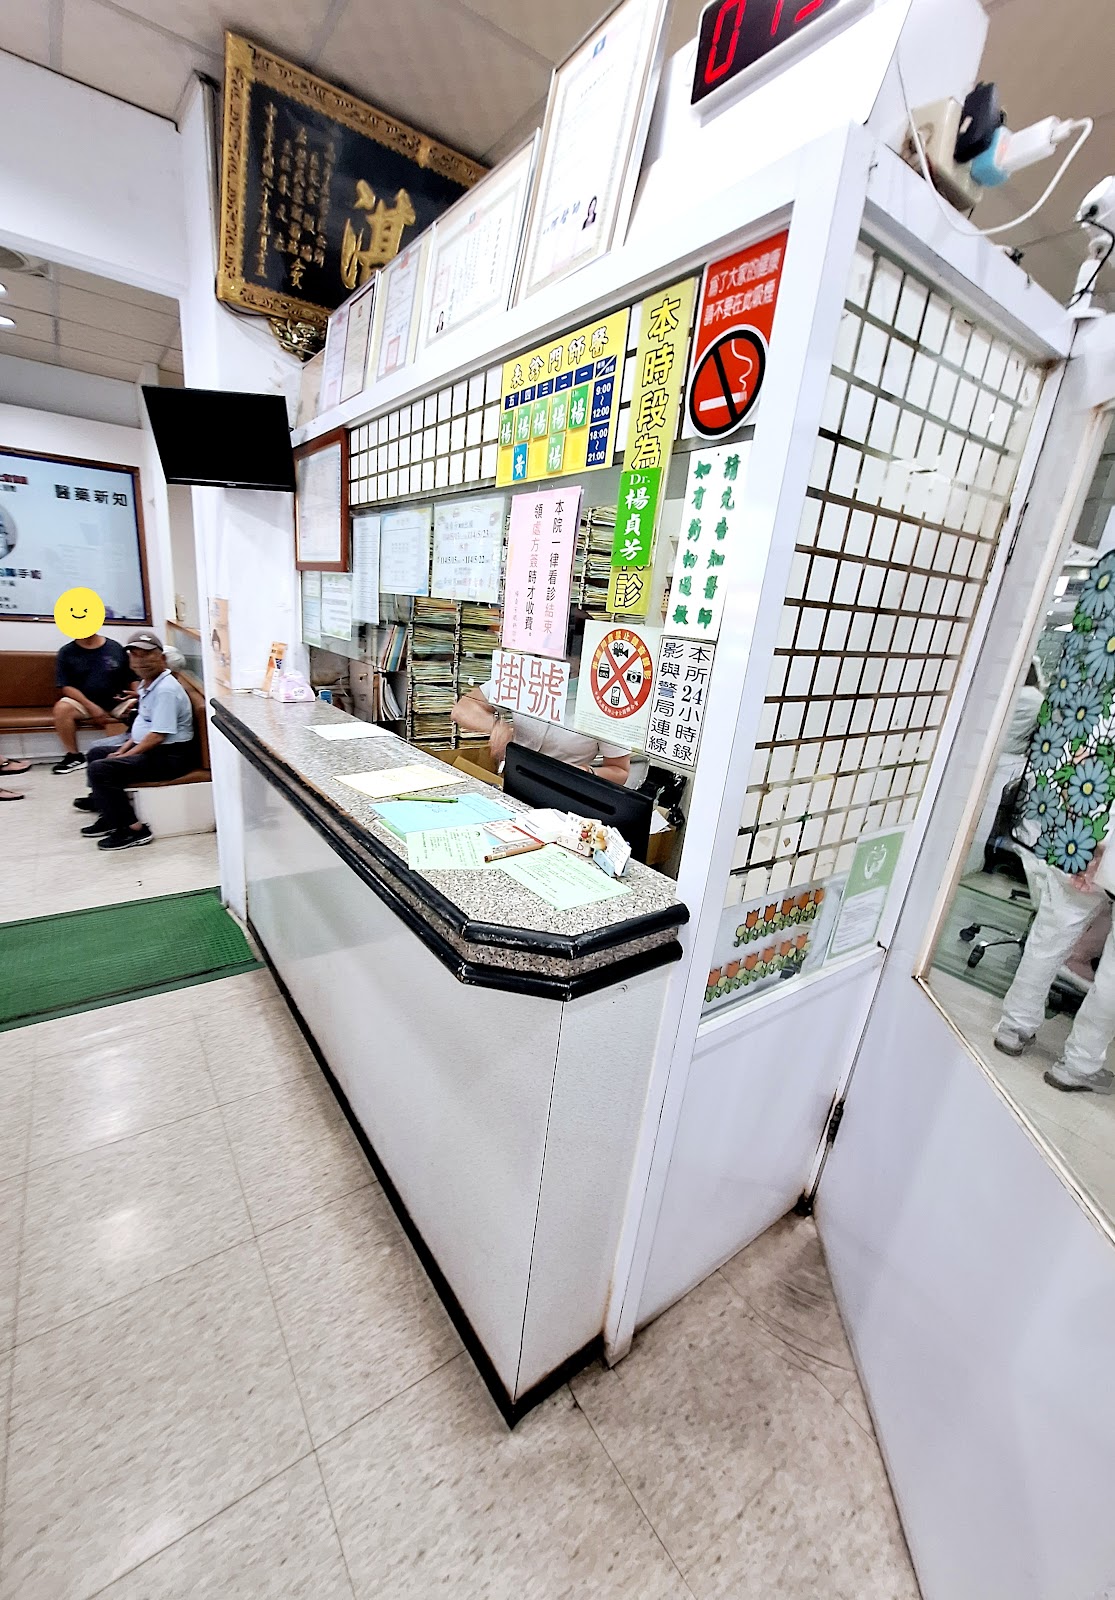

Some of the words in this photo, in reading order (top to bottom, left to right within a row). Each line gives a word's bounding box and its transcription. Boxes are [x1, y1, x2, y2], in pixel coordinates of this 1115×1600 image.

[631, 297, 681, 470] 本時段為
[517, 416, 529, 438] 楊
[533, 410, 546, 434] 楊
[552, 403, 565, 430] 楊
[570, 398, 586, 425] 楊
[501, 422, 512, 444] 楊
[548, 445, 561, 469] 楊
[54, 484, 128, 507] 醫藥新知
[629, 474, 650, 485] Dr.
[620, 486, 651, 561] 楊貞芳
[697, 454, 741, 629] 請先告知醫師
[543, 499, 565, 634] 本院一律看診結束
[614, 566, 644, 608] 診
[493, 653, 565, 723] 掛號
[647, 641, 685, 754] 影與警局連線
[672, 646, 712, 762] 本所24小時錄
